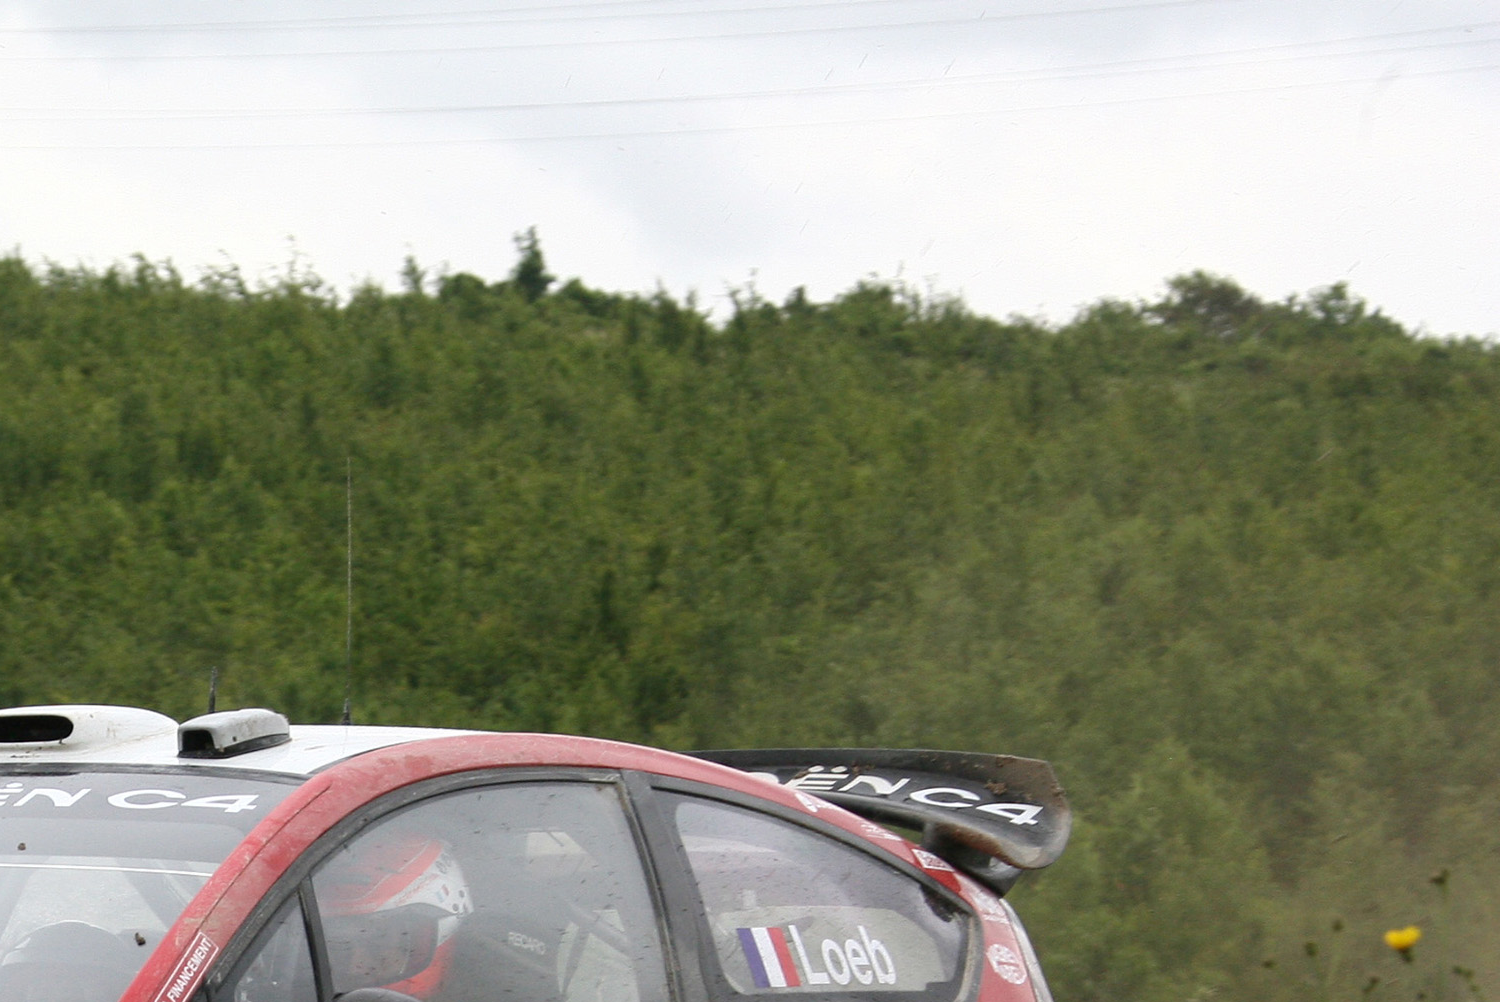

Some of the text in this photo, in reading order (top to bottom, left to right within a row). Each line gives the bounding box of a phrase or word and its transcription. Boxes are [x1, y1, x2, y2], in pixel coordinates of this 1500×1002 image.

[106, 788, 260, 814] C4
[747, 765, 1043, 826] ËN C4
[787, 924, 897, 985] Loeb
